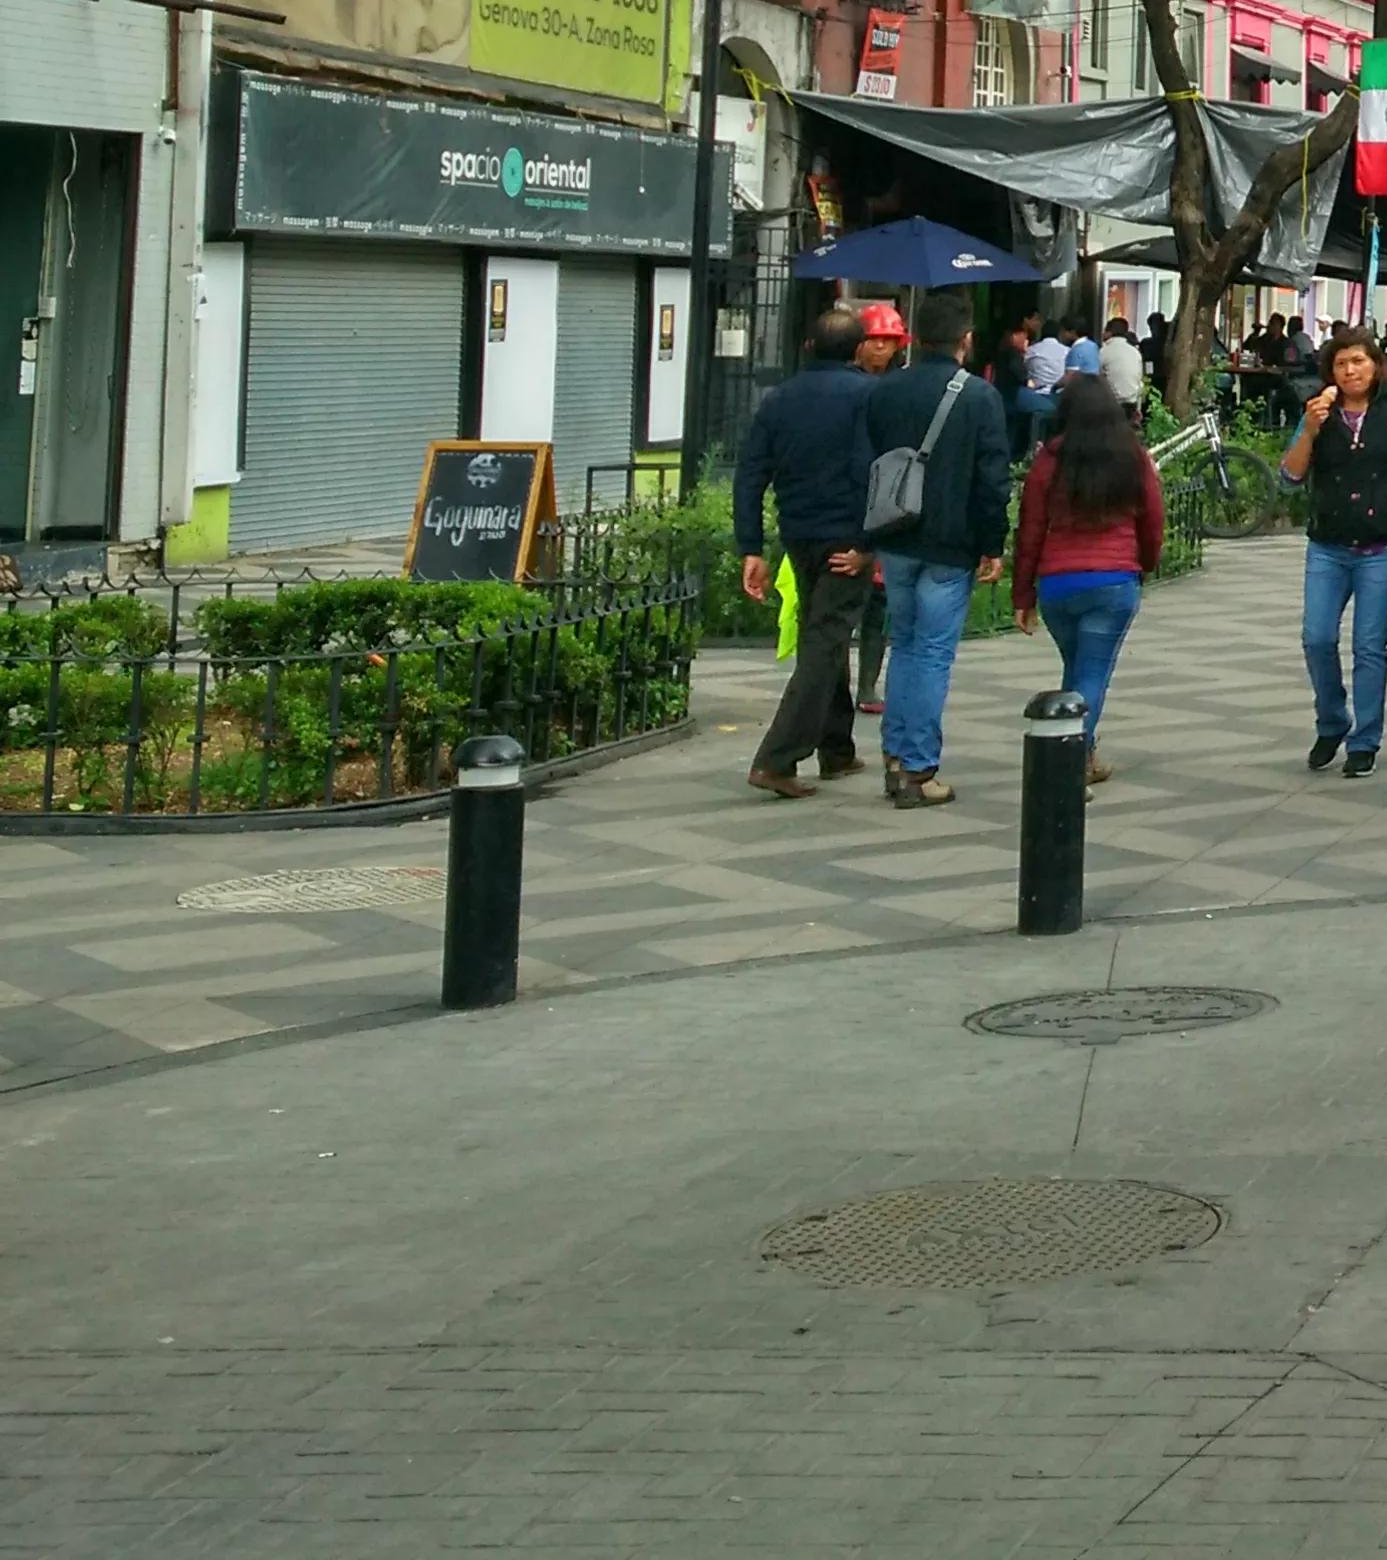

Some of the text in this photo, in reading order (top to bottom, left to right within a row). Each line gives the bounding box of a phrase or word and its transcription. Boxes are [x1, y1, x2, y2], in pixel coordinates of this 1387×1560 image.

[586, 17, 620, 50] Zona
[624, 25, 656, 56] Rosa
[440, 146, 592, 190] spacio oriental
